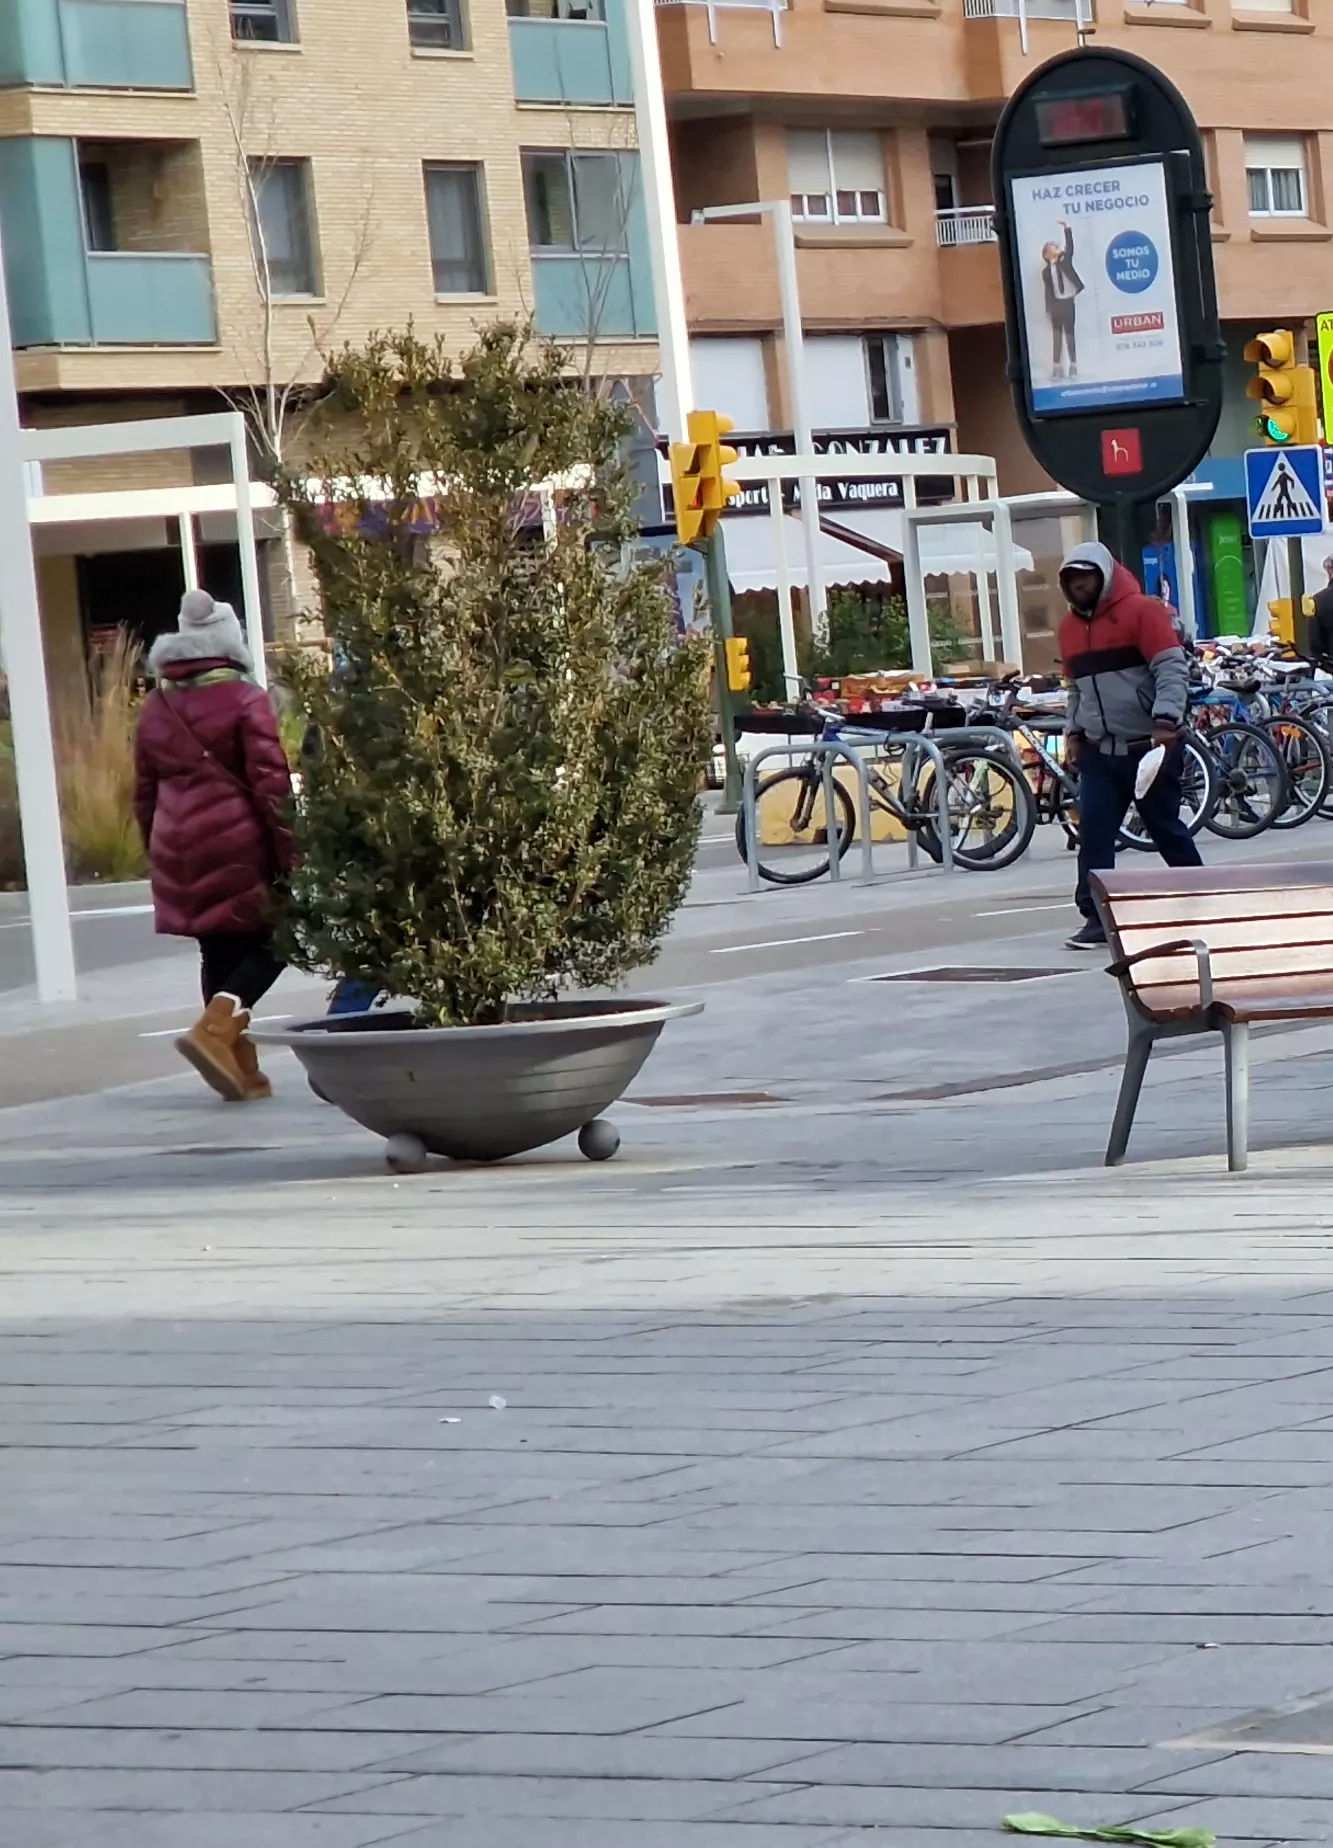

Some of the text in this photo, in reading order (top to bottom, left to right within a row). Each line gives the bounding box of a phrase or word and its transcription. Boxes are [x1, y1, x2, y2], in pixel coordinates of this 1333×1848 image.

[1032, 180, 1121, 201] HAZ CRECER
[1062, 194, 1150, 215] TU NEGOCIO
[1112, 245, 1149, 259] SOMOS
[1126, 258, 1139, 269] TU
[1116, 268, 1150, 280] MEDIO
[1112, 313, 1162, 329] URBAN
[837, 481, 899, 501] Vaquera
